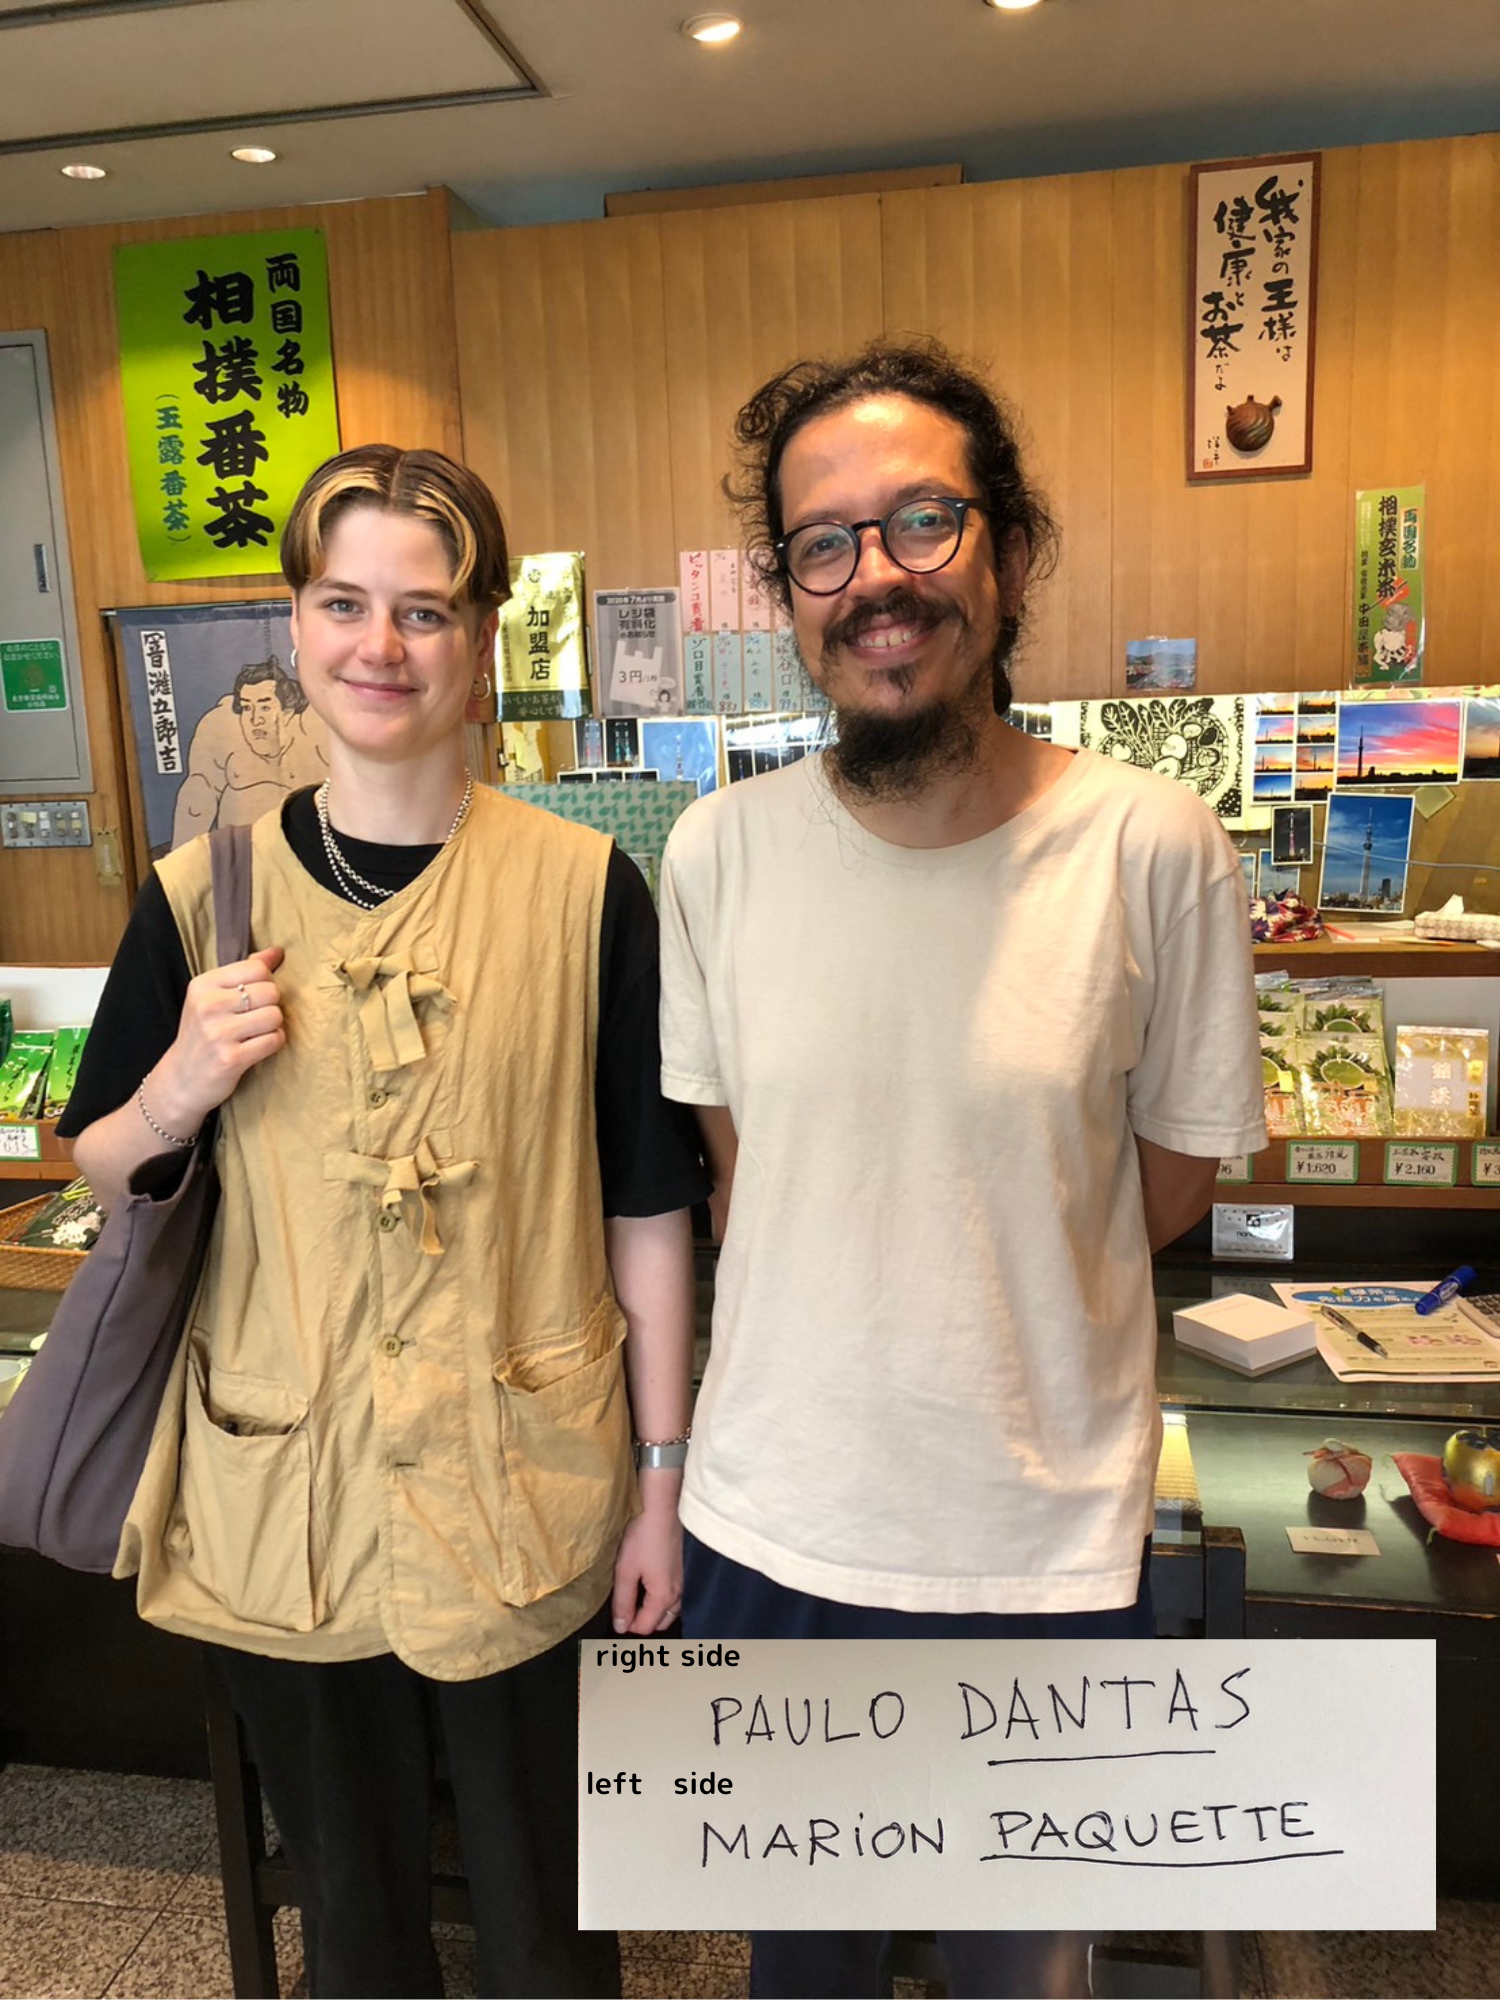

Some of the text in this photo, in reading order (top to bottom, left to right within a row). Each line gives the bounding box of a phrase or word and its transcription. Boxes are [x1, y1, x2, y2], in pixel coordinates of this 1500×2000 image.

[265, 252, 310, 418] 両国名物
[183, 269, 276, 549] 相撲番茶
[1376, 494, 1398, 598] 相撲玄米茶
[526, 605, 551, 681] 加盟店
[618, 607, 656, 619] レジ袋
[618, 619, 656, 630] 有料化
[710, 1667, 1251, 1746] PAULO DANTAS
[989, 1801, 1315, 1852] PAQUETTE
